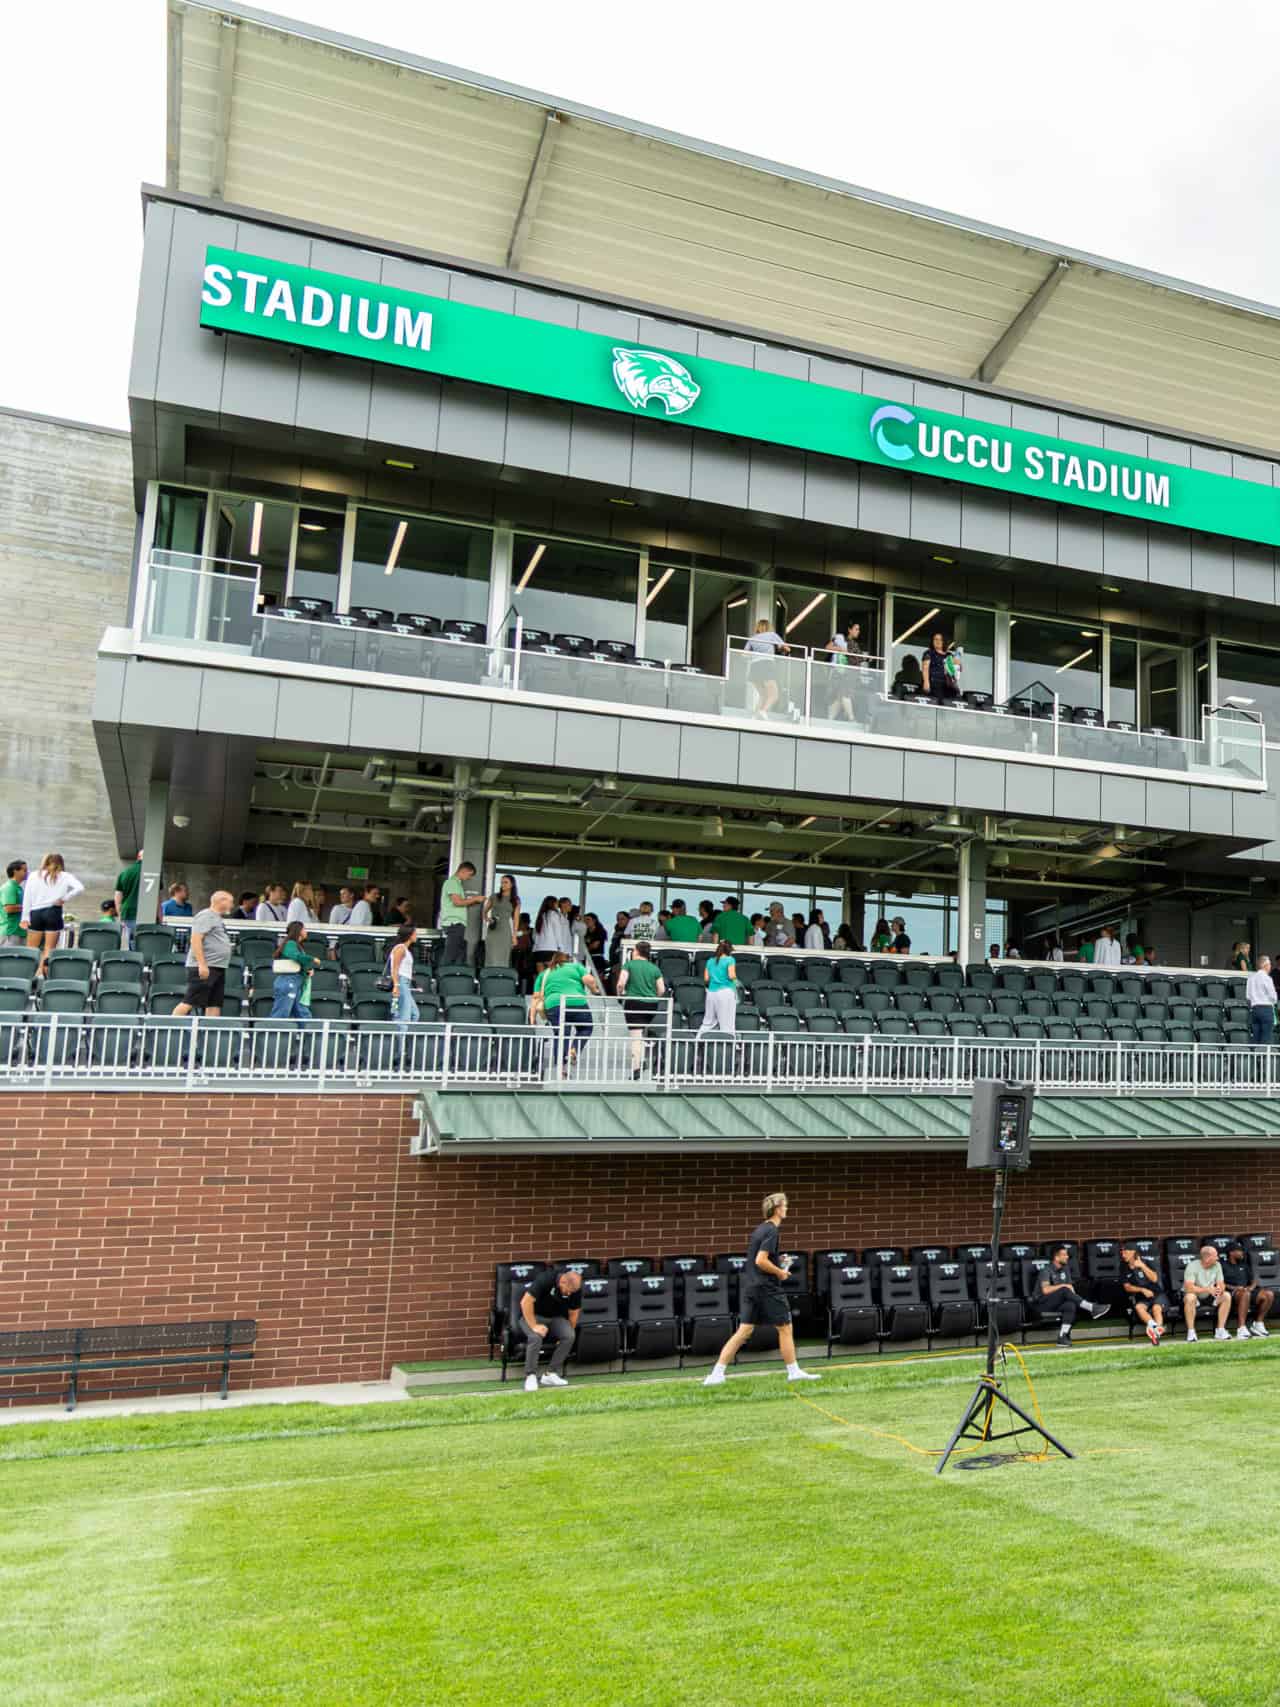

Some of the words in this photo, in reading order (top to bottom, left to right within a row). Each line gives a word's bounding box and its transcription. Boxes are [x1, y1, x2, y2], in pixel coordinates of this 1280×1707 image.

[202, 263, 433, 352] STADIUM
[918, 422, 1013, 473] UCCU
[1024, 446, 1170, 508] STADIUM
[144, 878, 155, 893] 7
